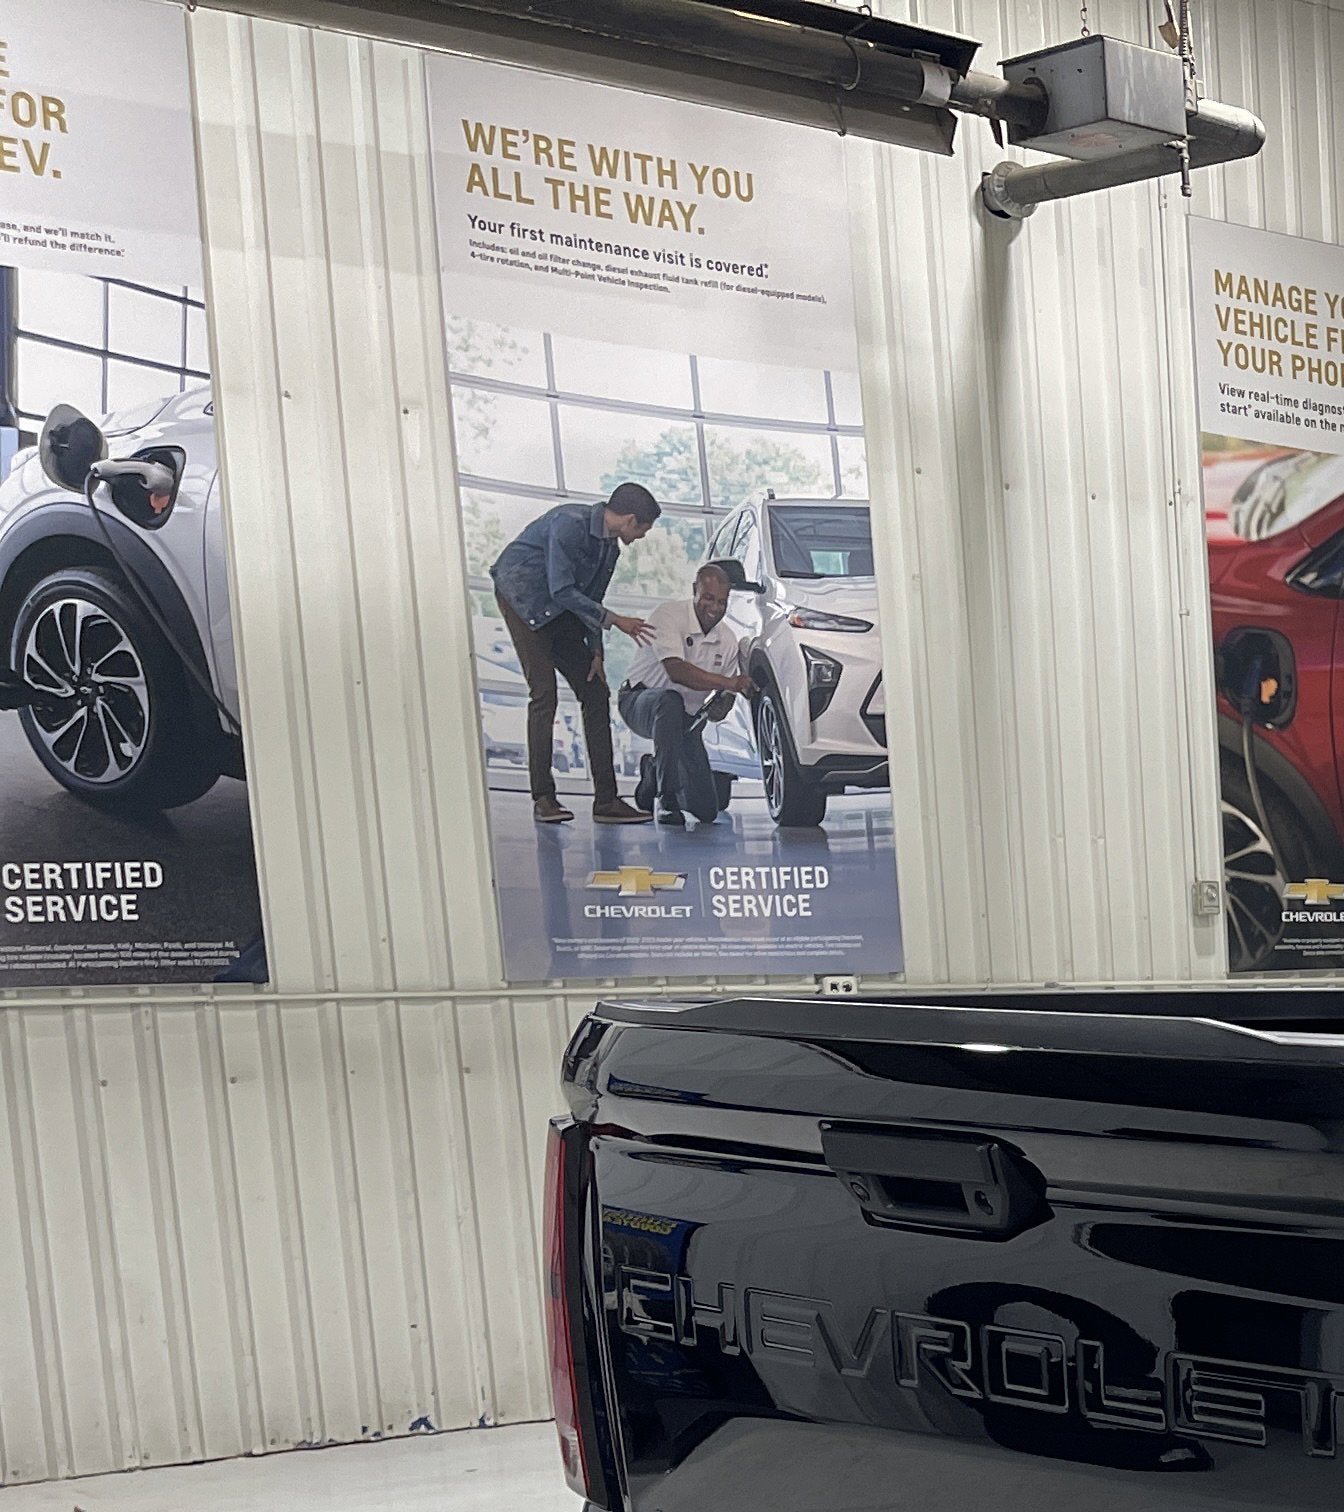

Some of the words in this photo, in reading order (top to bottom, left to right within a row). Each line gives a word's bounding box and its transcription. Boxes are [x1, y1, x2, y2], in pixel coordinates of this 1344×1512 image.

[0, 90, 68, 133] OR
[0, 135, 62, 179] EV.
[461, 118, 577, 171] WE'RE
[587, 143, 678, 190] WITH
[688, 161, 755, 202] YOU
[465, 162, 535, 205] ALL
[544, 176, 614, 219] THE
[622, 191, 705, 235] WAY.
[13, 236, 47, 248] refund
[50, 240, 67, 250] the
[23, 224, 42, 234] and
[70, 230, 102, 242] match
[467, 213, 505, 234] Your
[509, 222, 546, 242] first
[550, 232, 650, 261] maintenance
[653, 249, 686, 266] visit
[689, 252, 702, 268] is
[521, 249, 536, 259] and
[534, 264, 550, 273] and
[1213, 268, 1318, 316] MANAGE
[1214, 304, 1319, 350] VEHICLE
[1216, 338, 1283, 377] YOUR
[1218, 382, 1246, 399] View
[1248, 390, 1299, 409] real-time
[1254, 409, 1301, 426] available
[1304, 418, 1317, 429] on
[1320, 417, 1337, 432] the
[1, 861, 164, 890] CERTIFIED
[708, 865, 829, 891] CERTIFIED
[4, 893, 140, 923] SERVICE
[583, 905, 693, 919] CHEVROLET
[711, 893, 813, 918] SERVICE
